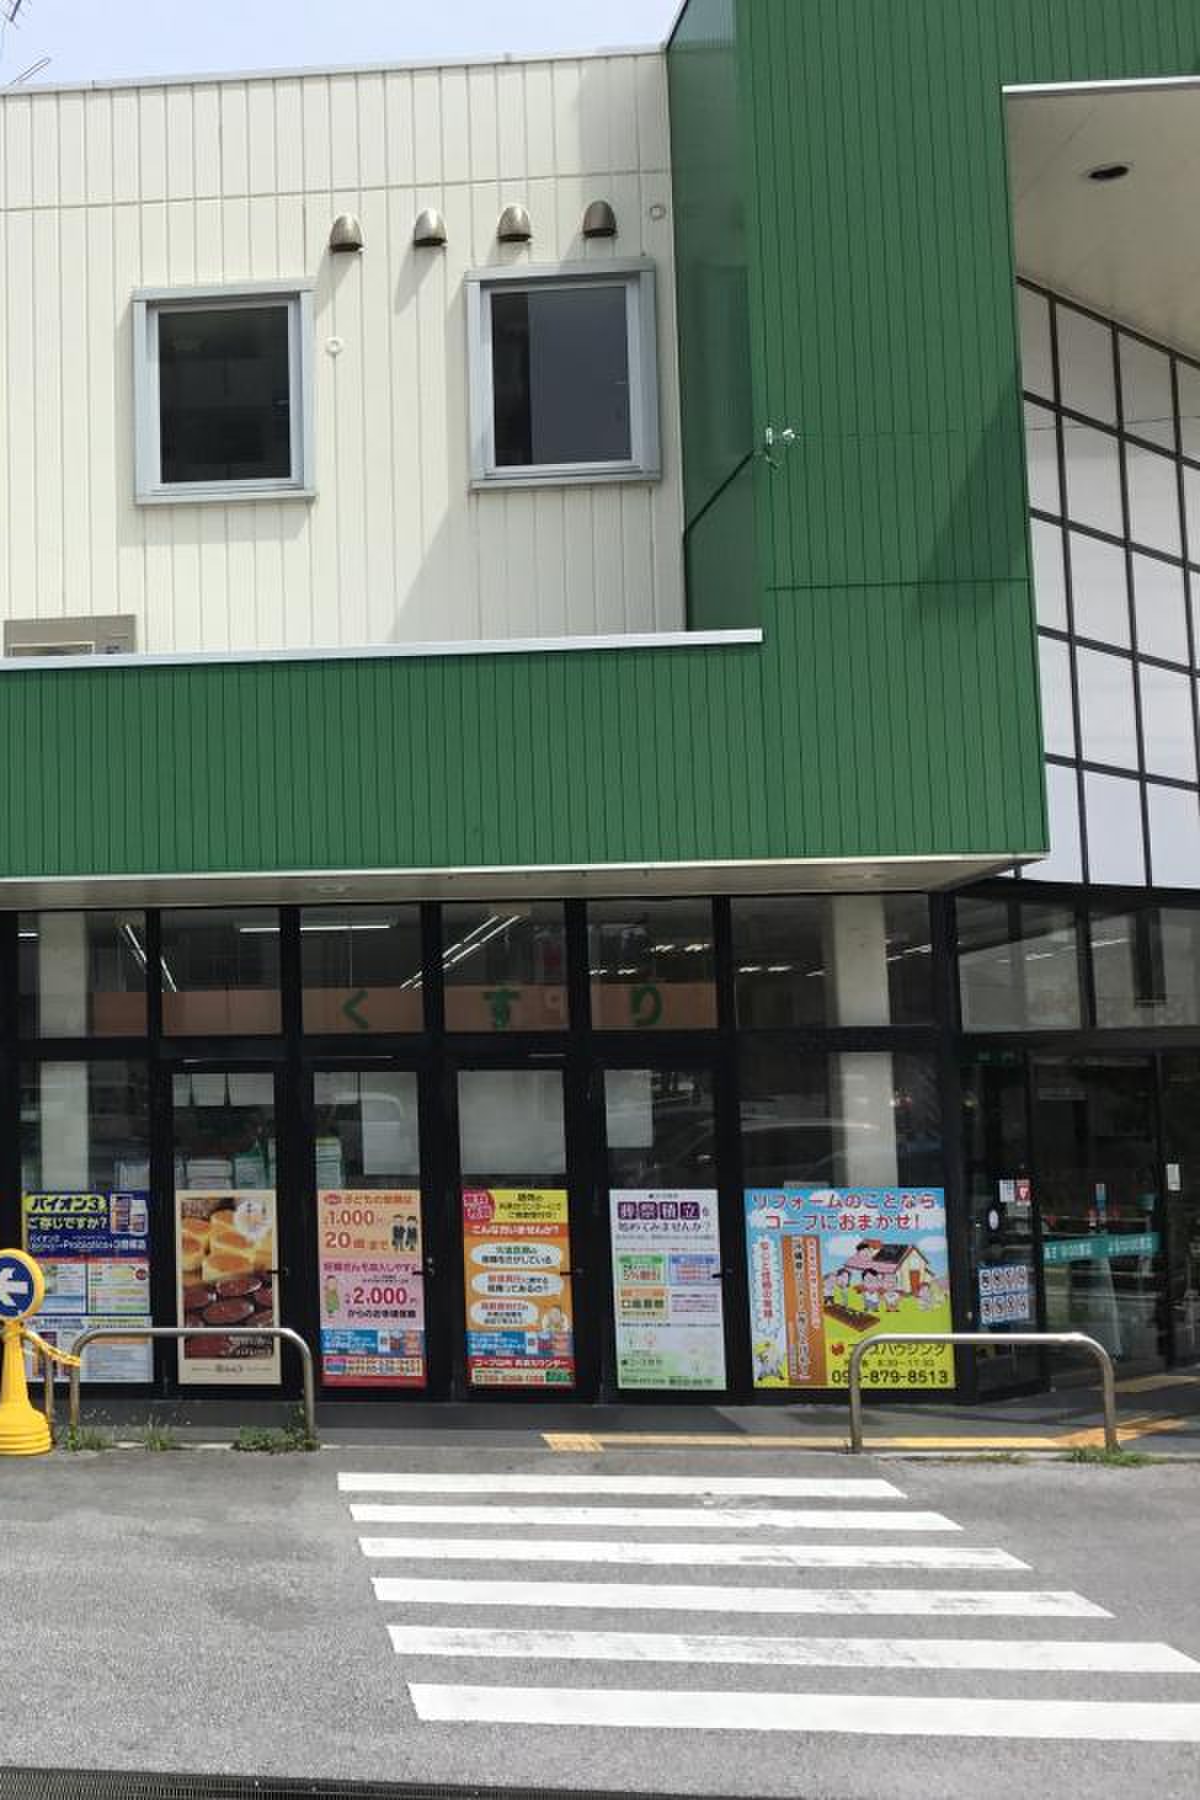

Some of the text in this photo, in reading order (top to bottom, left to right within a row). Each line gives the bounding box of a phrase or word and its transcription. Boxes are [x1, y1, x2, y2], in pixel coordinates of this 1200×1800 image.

[752, 1193, 936, 1210] リフォームのことなら
[831, 1369, 949, 1385] 09-879-8513
